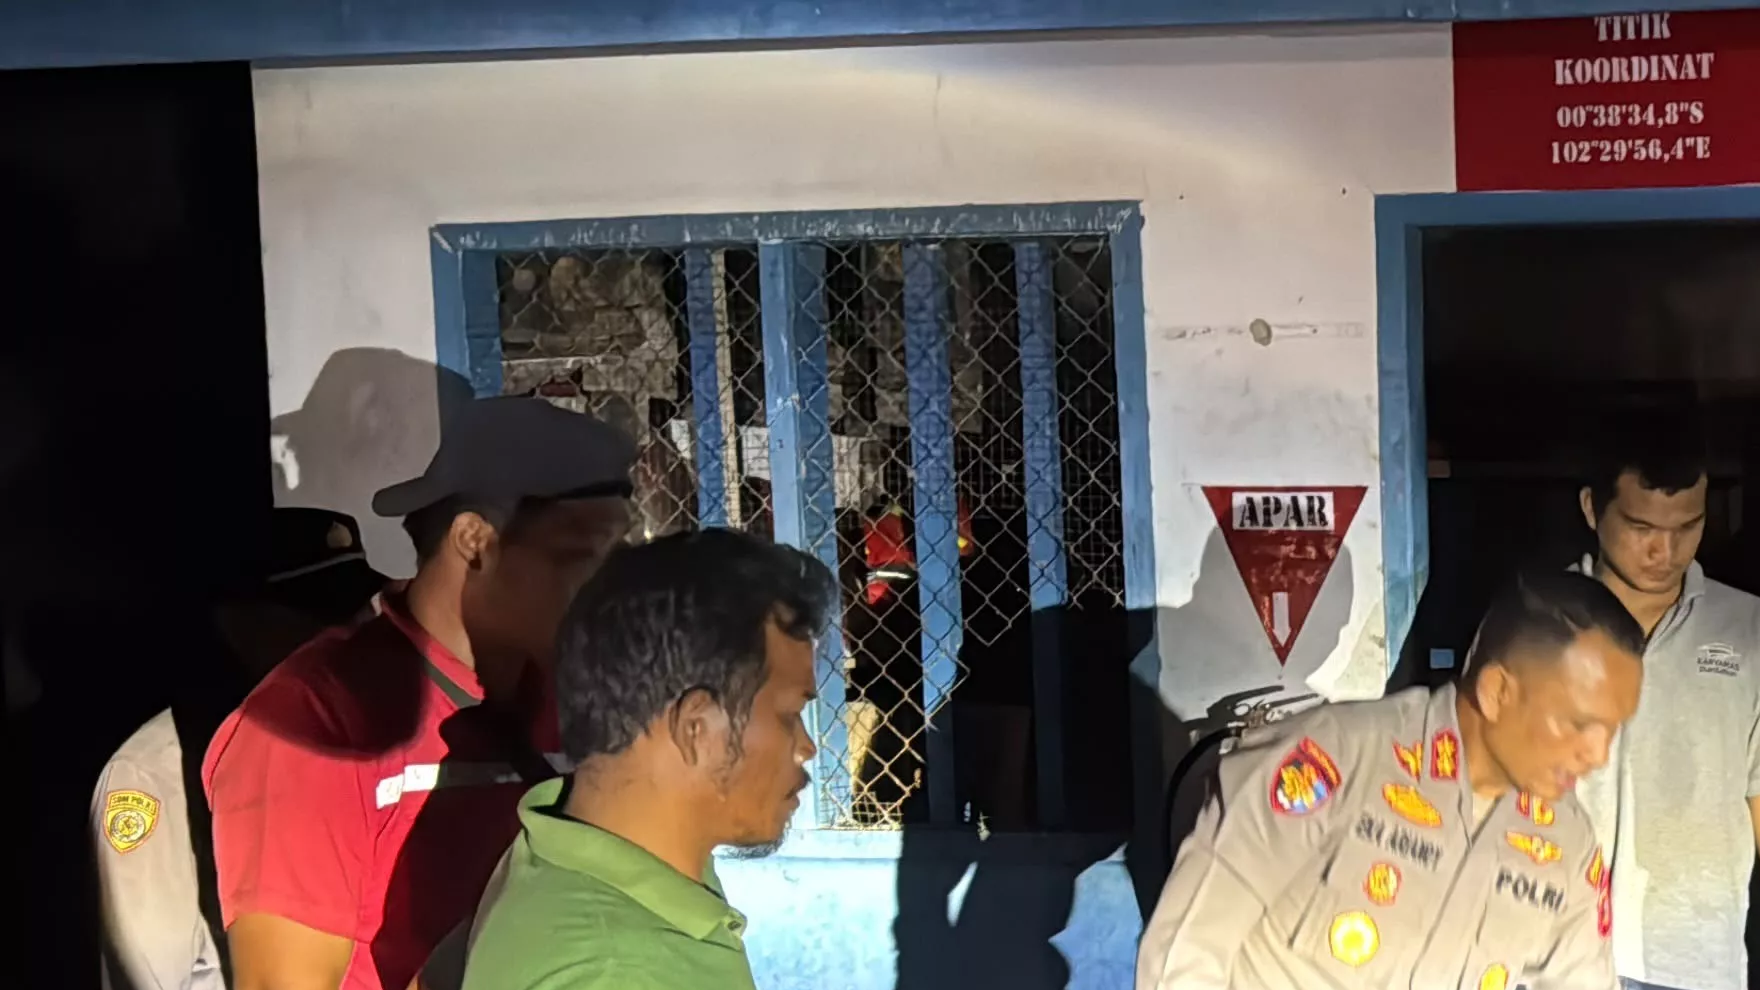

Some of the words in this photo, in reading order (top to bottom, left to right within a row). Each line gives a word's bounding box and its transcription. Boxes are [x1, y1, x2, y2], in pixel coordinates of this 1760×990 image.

[1594, 12, 1672, 41] TITIK
[1554, 53, 1714, 85] KOORDINAT
[1239, 495, 1328, 528] APAR
